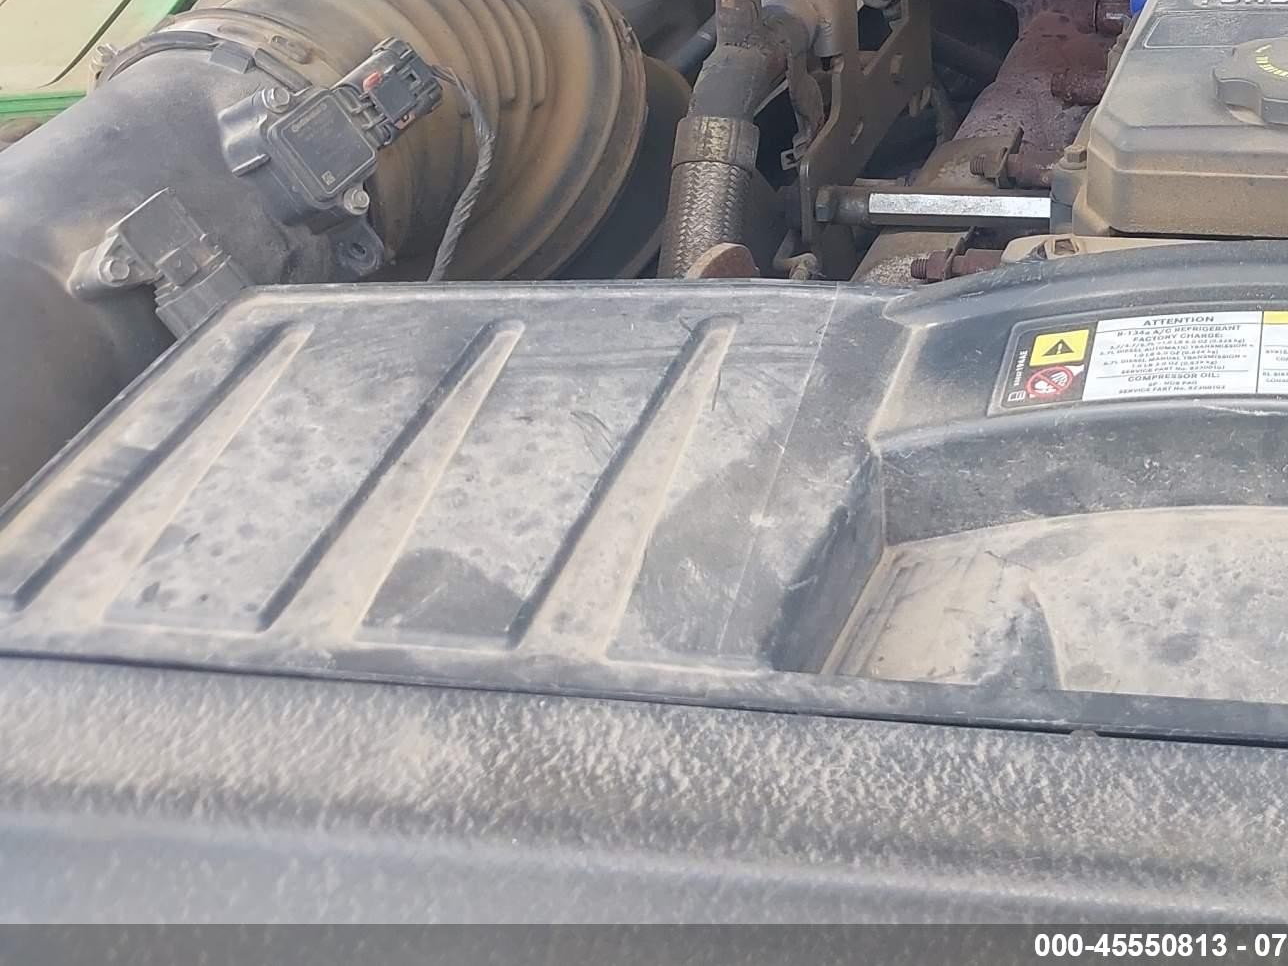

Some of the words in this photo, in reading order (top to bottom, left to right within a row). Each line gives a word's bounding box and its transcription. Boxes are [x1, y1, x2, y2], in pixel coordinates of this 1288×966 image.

[1143, 316, 1215, 327] ATTENTION
[1133, 334, 1178, 342] FACTORY
[1127, 373, 1198, 382] COMPRESSOR
